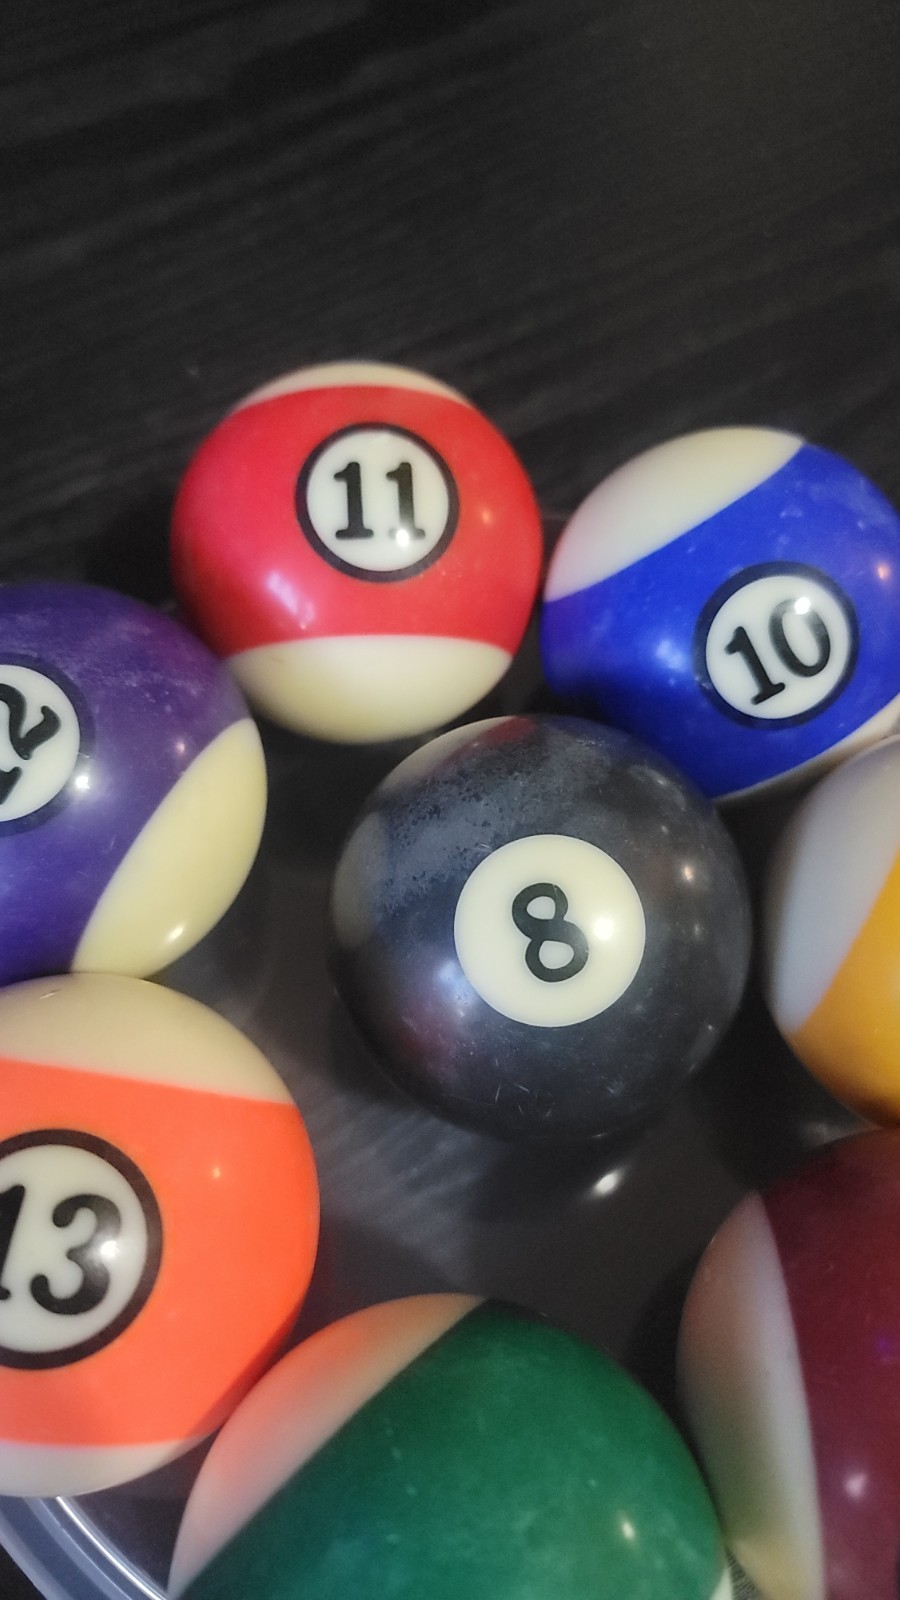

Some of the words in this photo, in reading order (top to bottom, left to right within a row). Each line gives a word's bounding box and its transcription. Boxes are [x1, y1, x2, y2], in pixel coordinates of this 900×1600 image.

[334, 462, 426, 540] 11
[724, 598, 831, 705] 10
[0, 683, 61, 805] 2
[512, 882, 589, 983] 8
